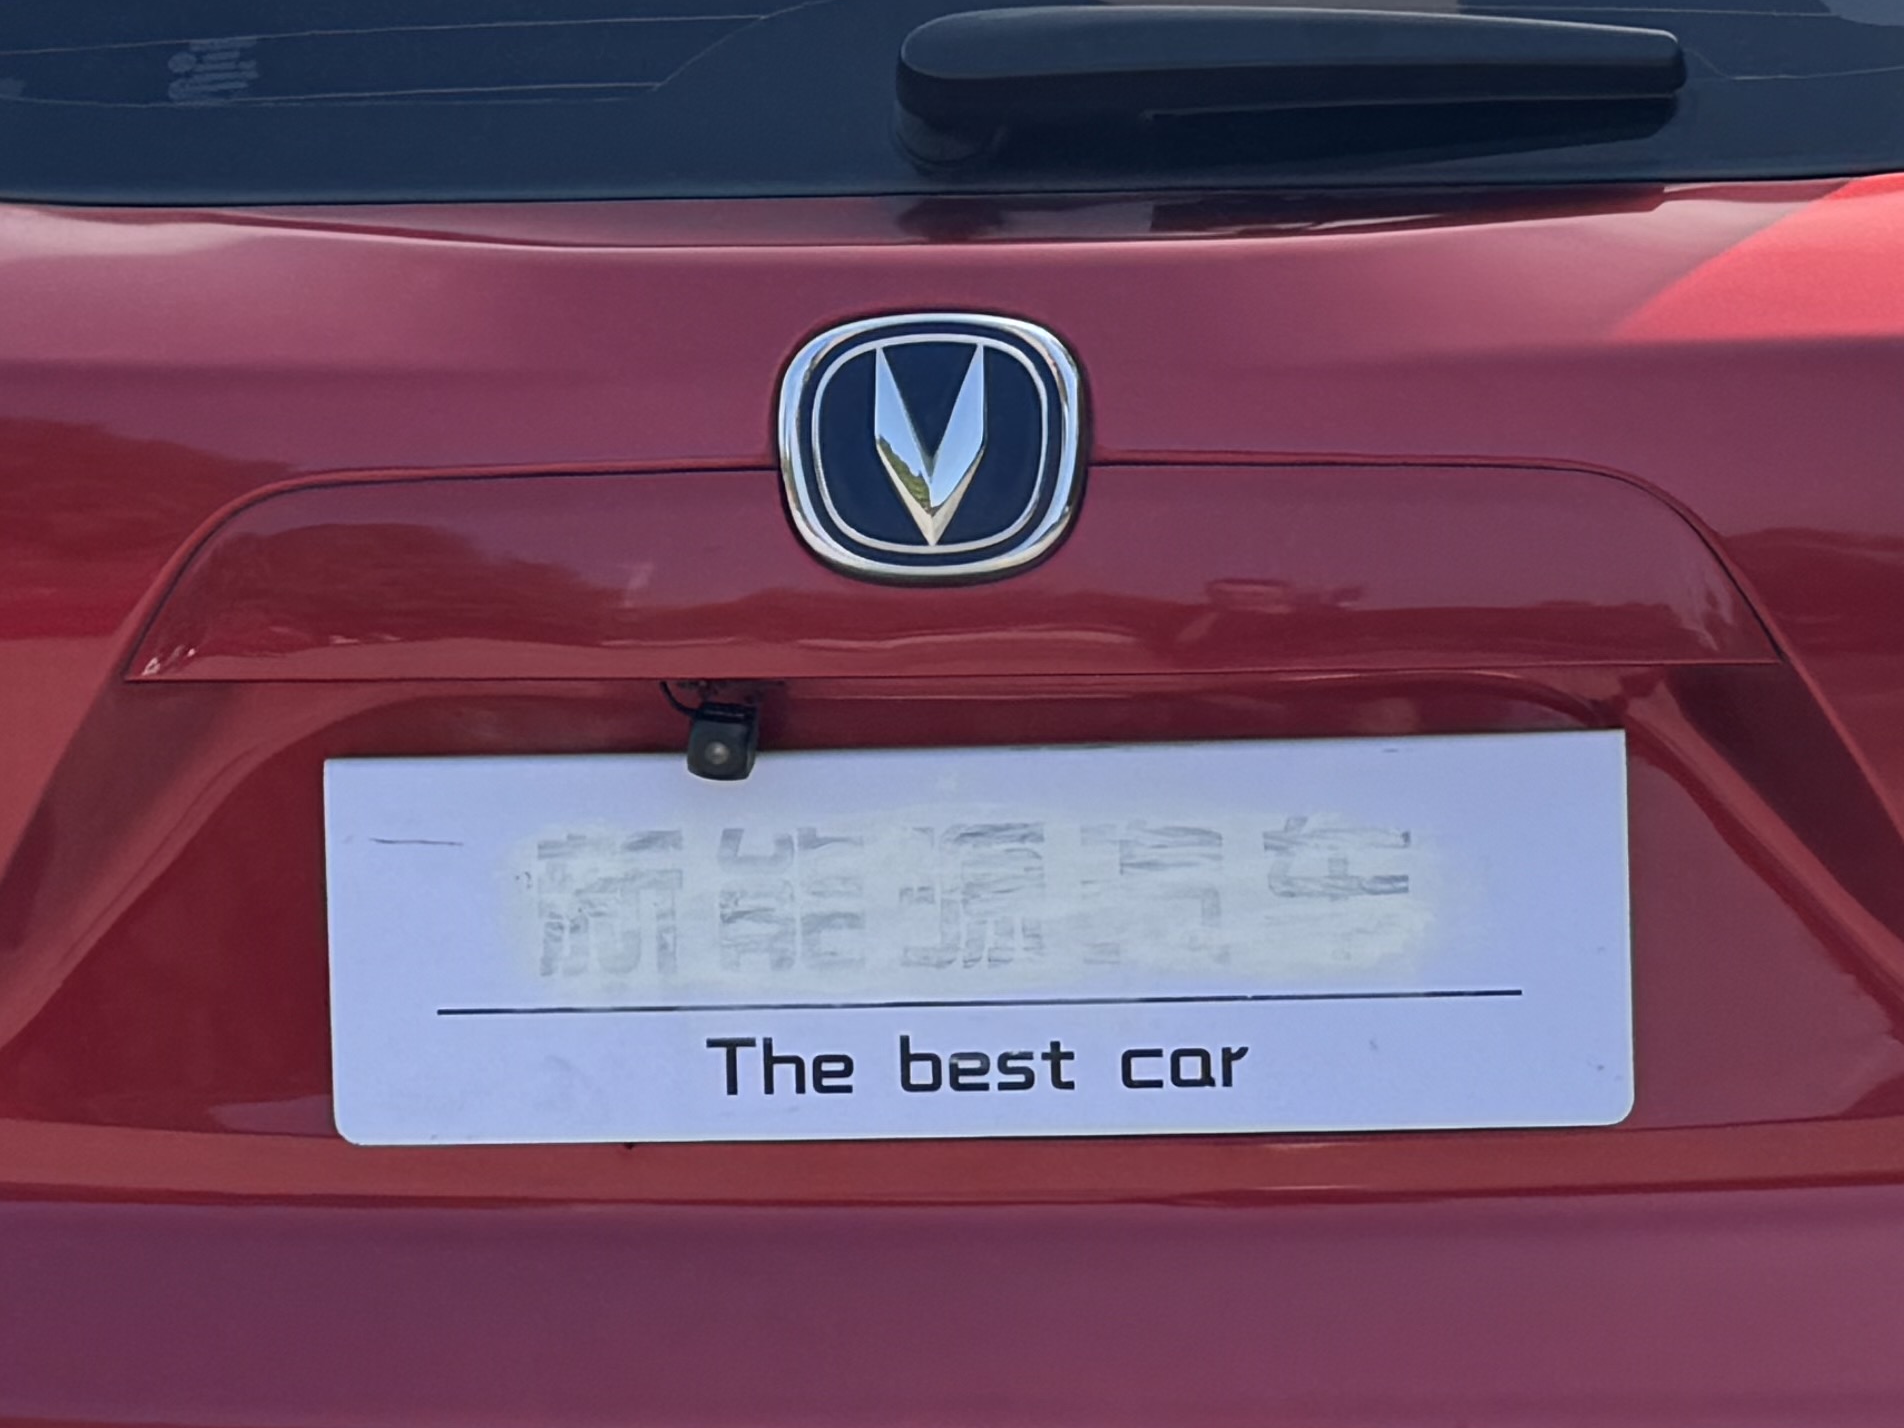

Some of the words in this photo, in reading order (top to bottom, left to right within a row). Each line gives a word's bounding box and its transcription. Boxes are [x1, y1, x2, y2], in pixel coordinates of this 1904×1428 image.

[706, 1038, 853, 1095] The
[900, 1035, 1075, 1092] best
[1122, 1047, 1248, 1088] car
